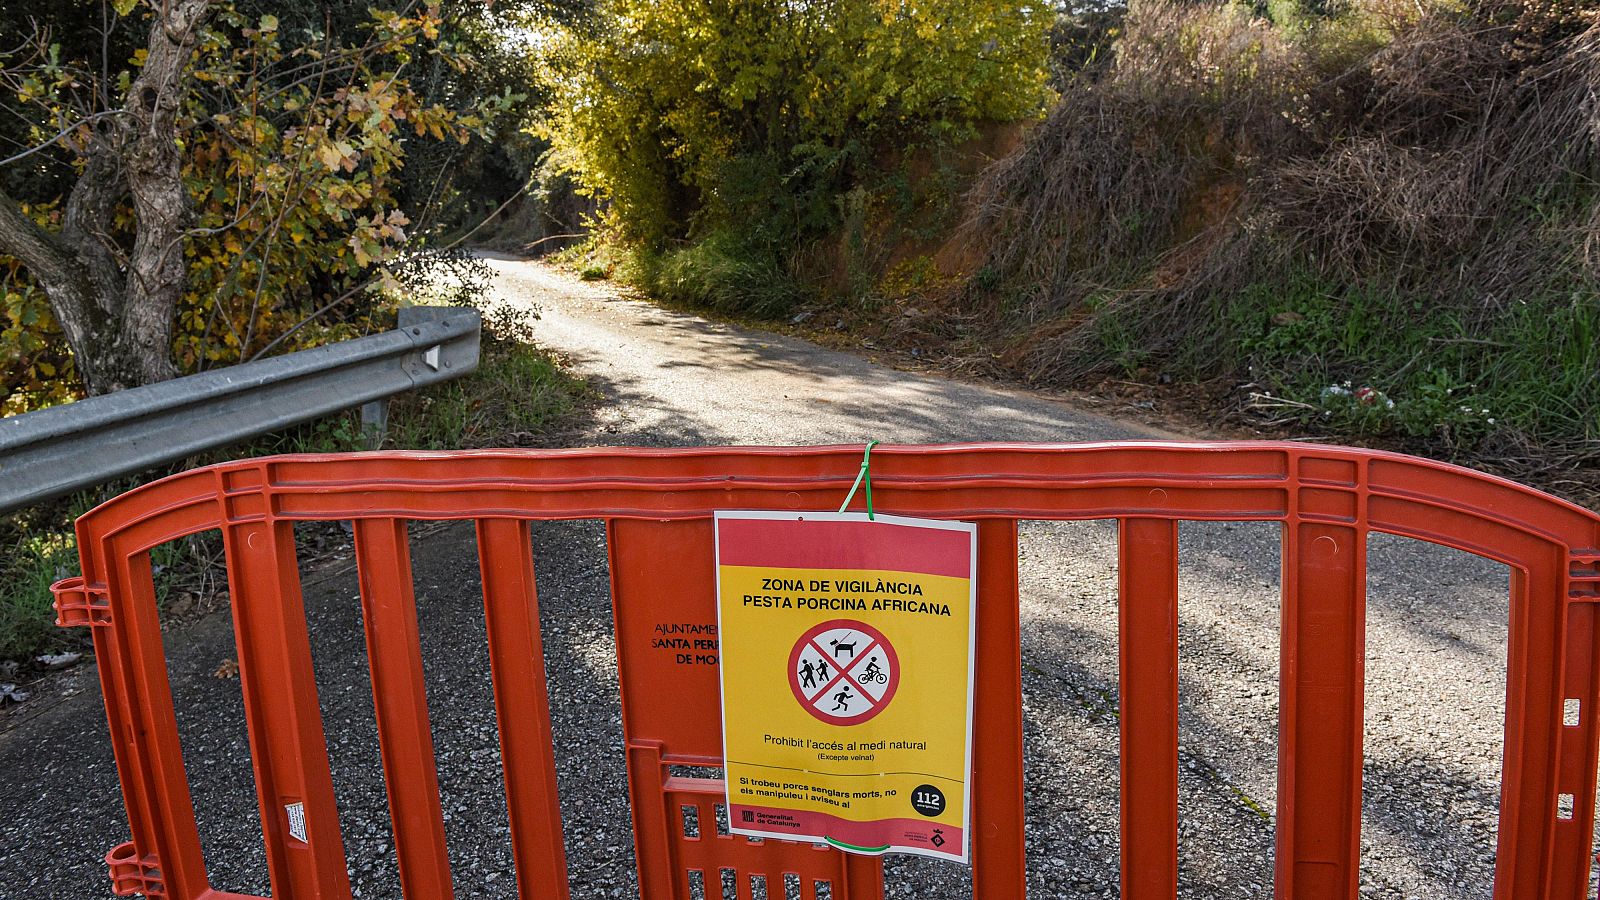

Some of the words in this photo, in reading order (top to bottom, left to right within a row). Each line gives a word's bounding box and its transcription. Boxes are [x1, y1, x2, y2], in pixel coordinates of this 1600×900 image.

[762, 578, 805, 592] ZONA
[809, 580, 830, 592] DE
[835, 578, 923, 596] VIGILÀNCIA
[743, 595, 792, 609] PESTA
[797, 597, 867, 611] PORCINA
[871, 599, 951, 616] AFRICANA
[652, 639, 690, 649] SANTA
[676, 654, 692, 664] DE
[696, 655, 719, 665] MO
[764, 734, 803, 748] Prohibit
[847, 741, 856, 751] al
[859, 741, 886, 750] medi
[889, 740, 926, 751] natural
[817, 753, 849, 762] (Excepte
[740, 777, 749, 785] Si
[751, 778, 780, 788] trobeu
[783, 782, 809, 791] porcs
[811, 786, 850, 799] senglars
[852, 791, 882, 799] morts,
[885, 789, 897, 797] no
[740, 787, 754, 795] els
[756, 789, 803, 800] manipuleu
[811, 794, 840, 806] aviseu
[841, 801, 850, 809] al
[917, 791, 940, 805] 112
[756, 812, 794, 821] Generalitat
[767, 819, 801, 828] Catalunya
